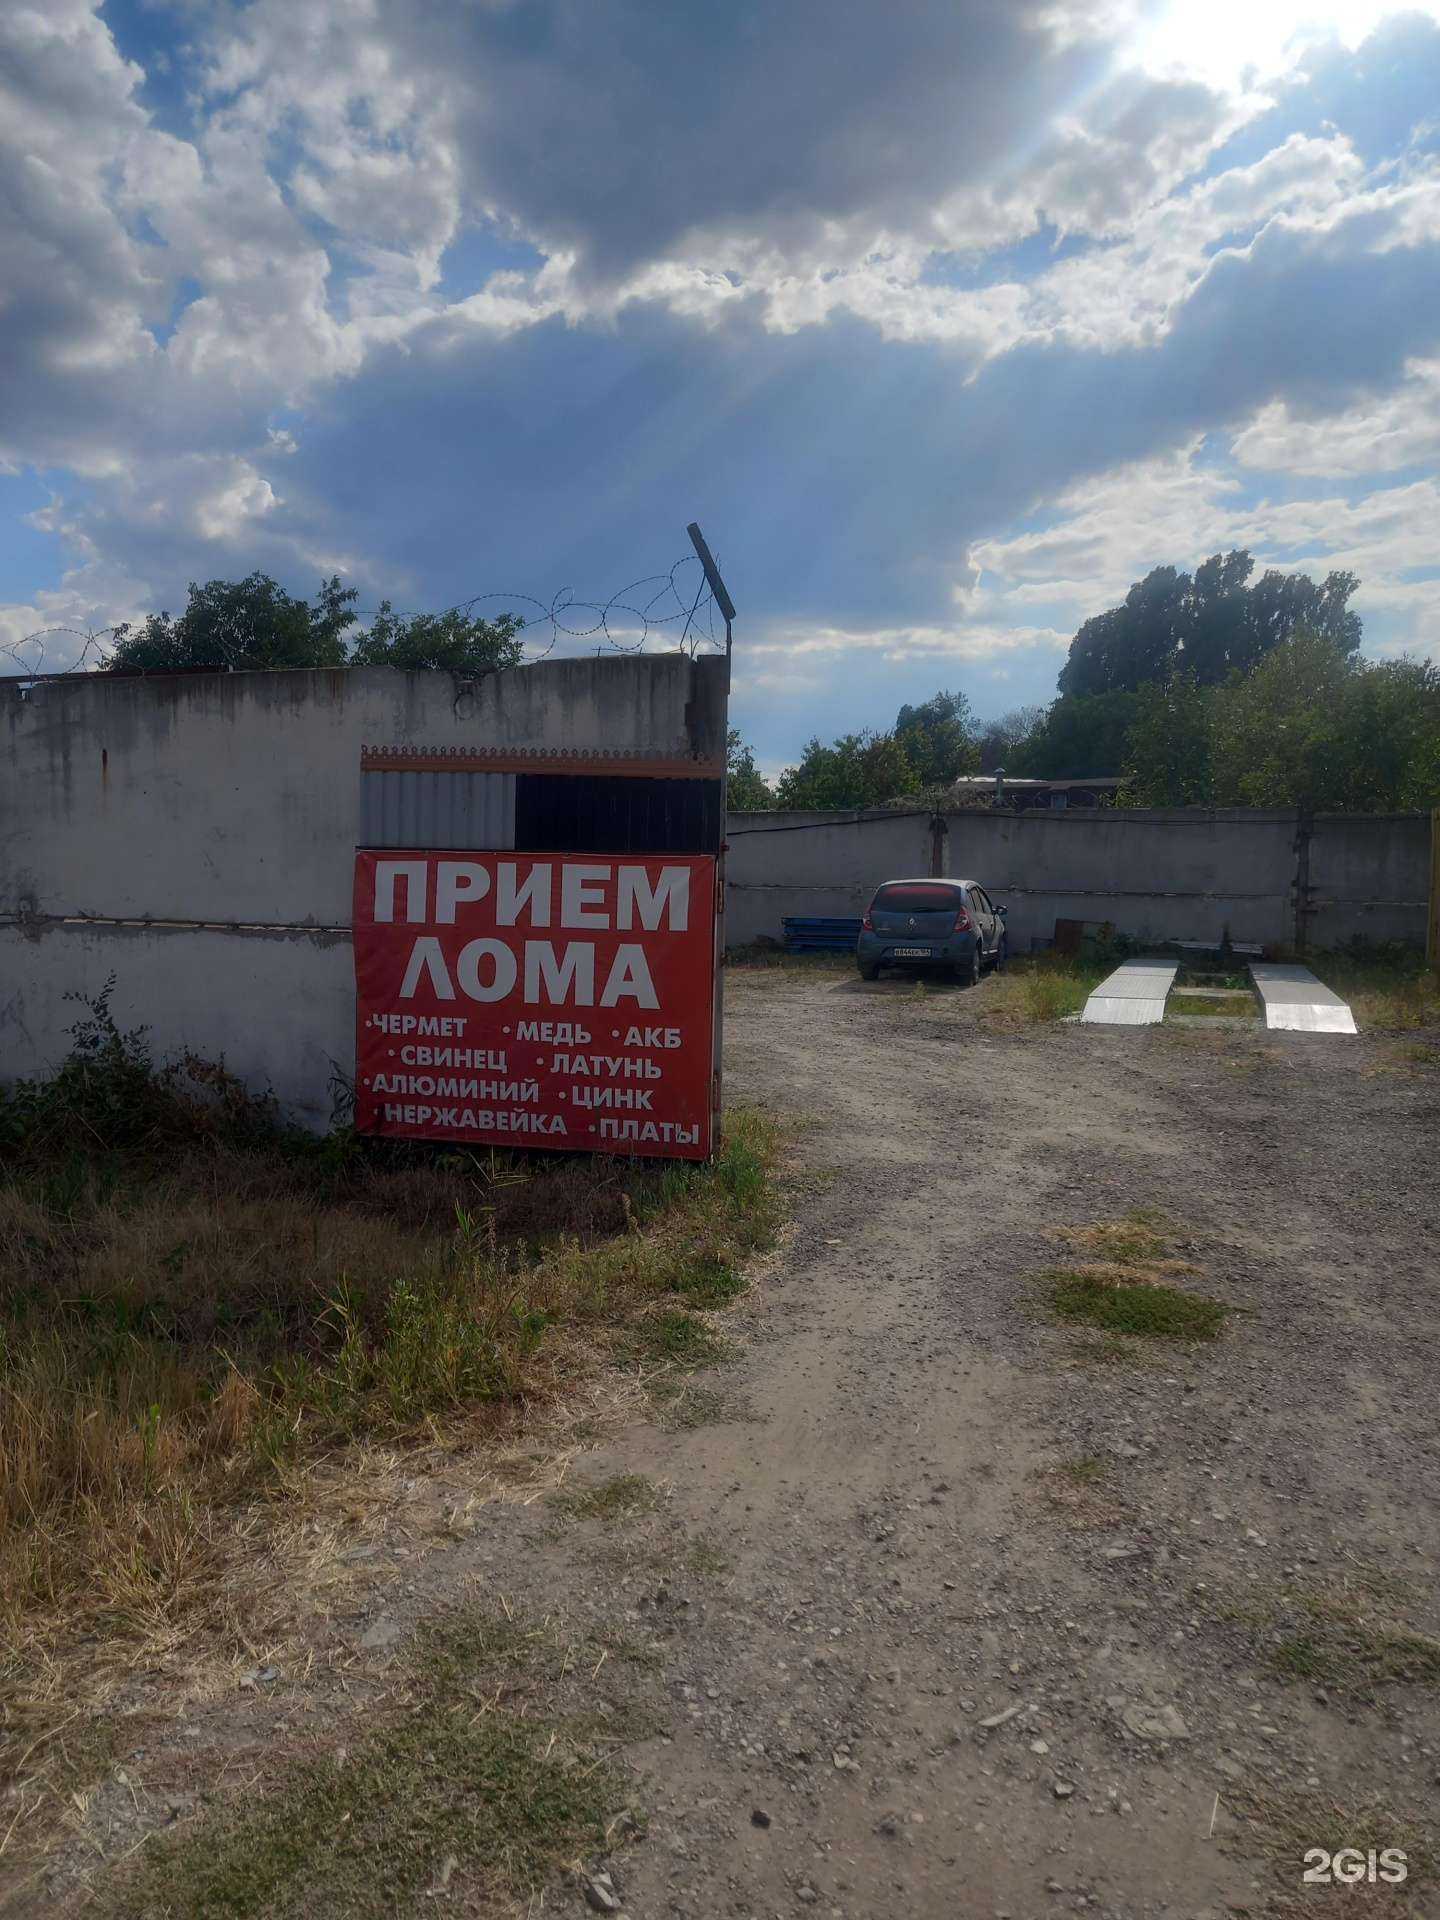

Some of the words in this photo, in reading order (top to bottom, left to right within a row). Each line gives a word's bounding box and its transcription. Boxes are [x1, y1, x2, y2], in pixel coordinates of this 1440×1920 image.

[373, 860, 691, 931] ПРИЕМ
[399, 936, 661, 1009] ЛОМА
[373, 1014, 467, 1037] ЧЕРМЕТ
[516, 1021, 592, 1046] МЕДЬ
[624, 1027, 682, 1048] АКБ
[400, 1045, 508, 1074] СВИНЕЦ
[550, 1053, 662, 1079] ЛАТУНЬ
[372, 1073, 539, 1102] АЛЮМИНИЙ
[572, 1085, 654, 1110] ЦИНК
[384, 1103, 567, 1135] НЕРЖАВЕЙКА
[600, 1118, 699, 1145] ПЛАТЫ
